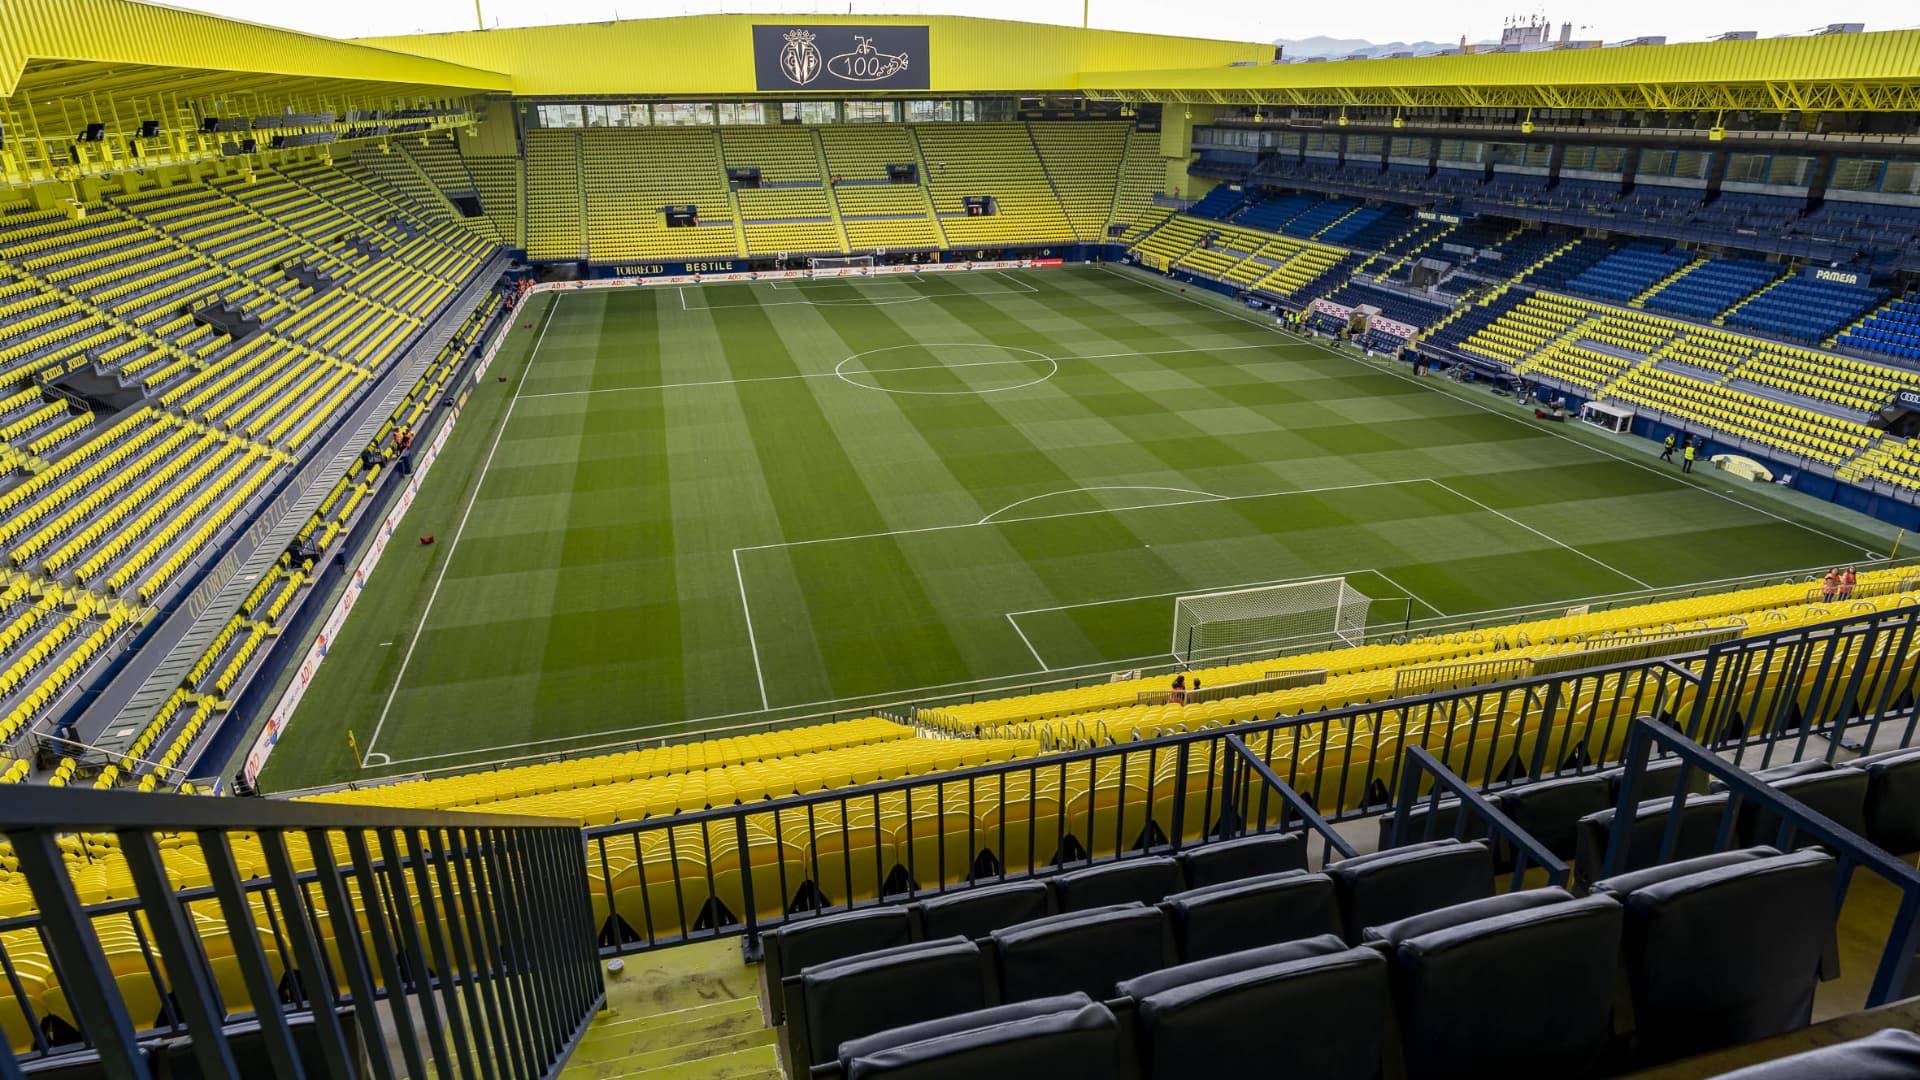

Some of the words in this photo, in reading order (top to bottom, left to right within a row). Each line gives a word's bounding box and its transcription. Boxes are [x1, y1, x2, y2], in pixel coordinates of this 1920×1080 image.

[844, 57, 879, 76] 100
[613, 264, 664, 276] TORRECID
[686, 261, 733, 273] BESTILE
[1815, 269, 1857, 285] PAMESA
[249, 493, 291, 549] BESTILE
